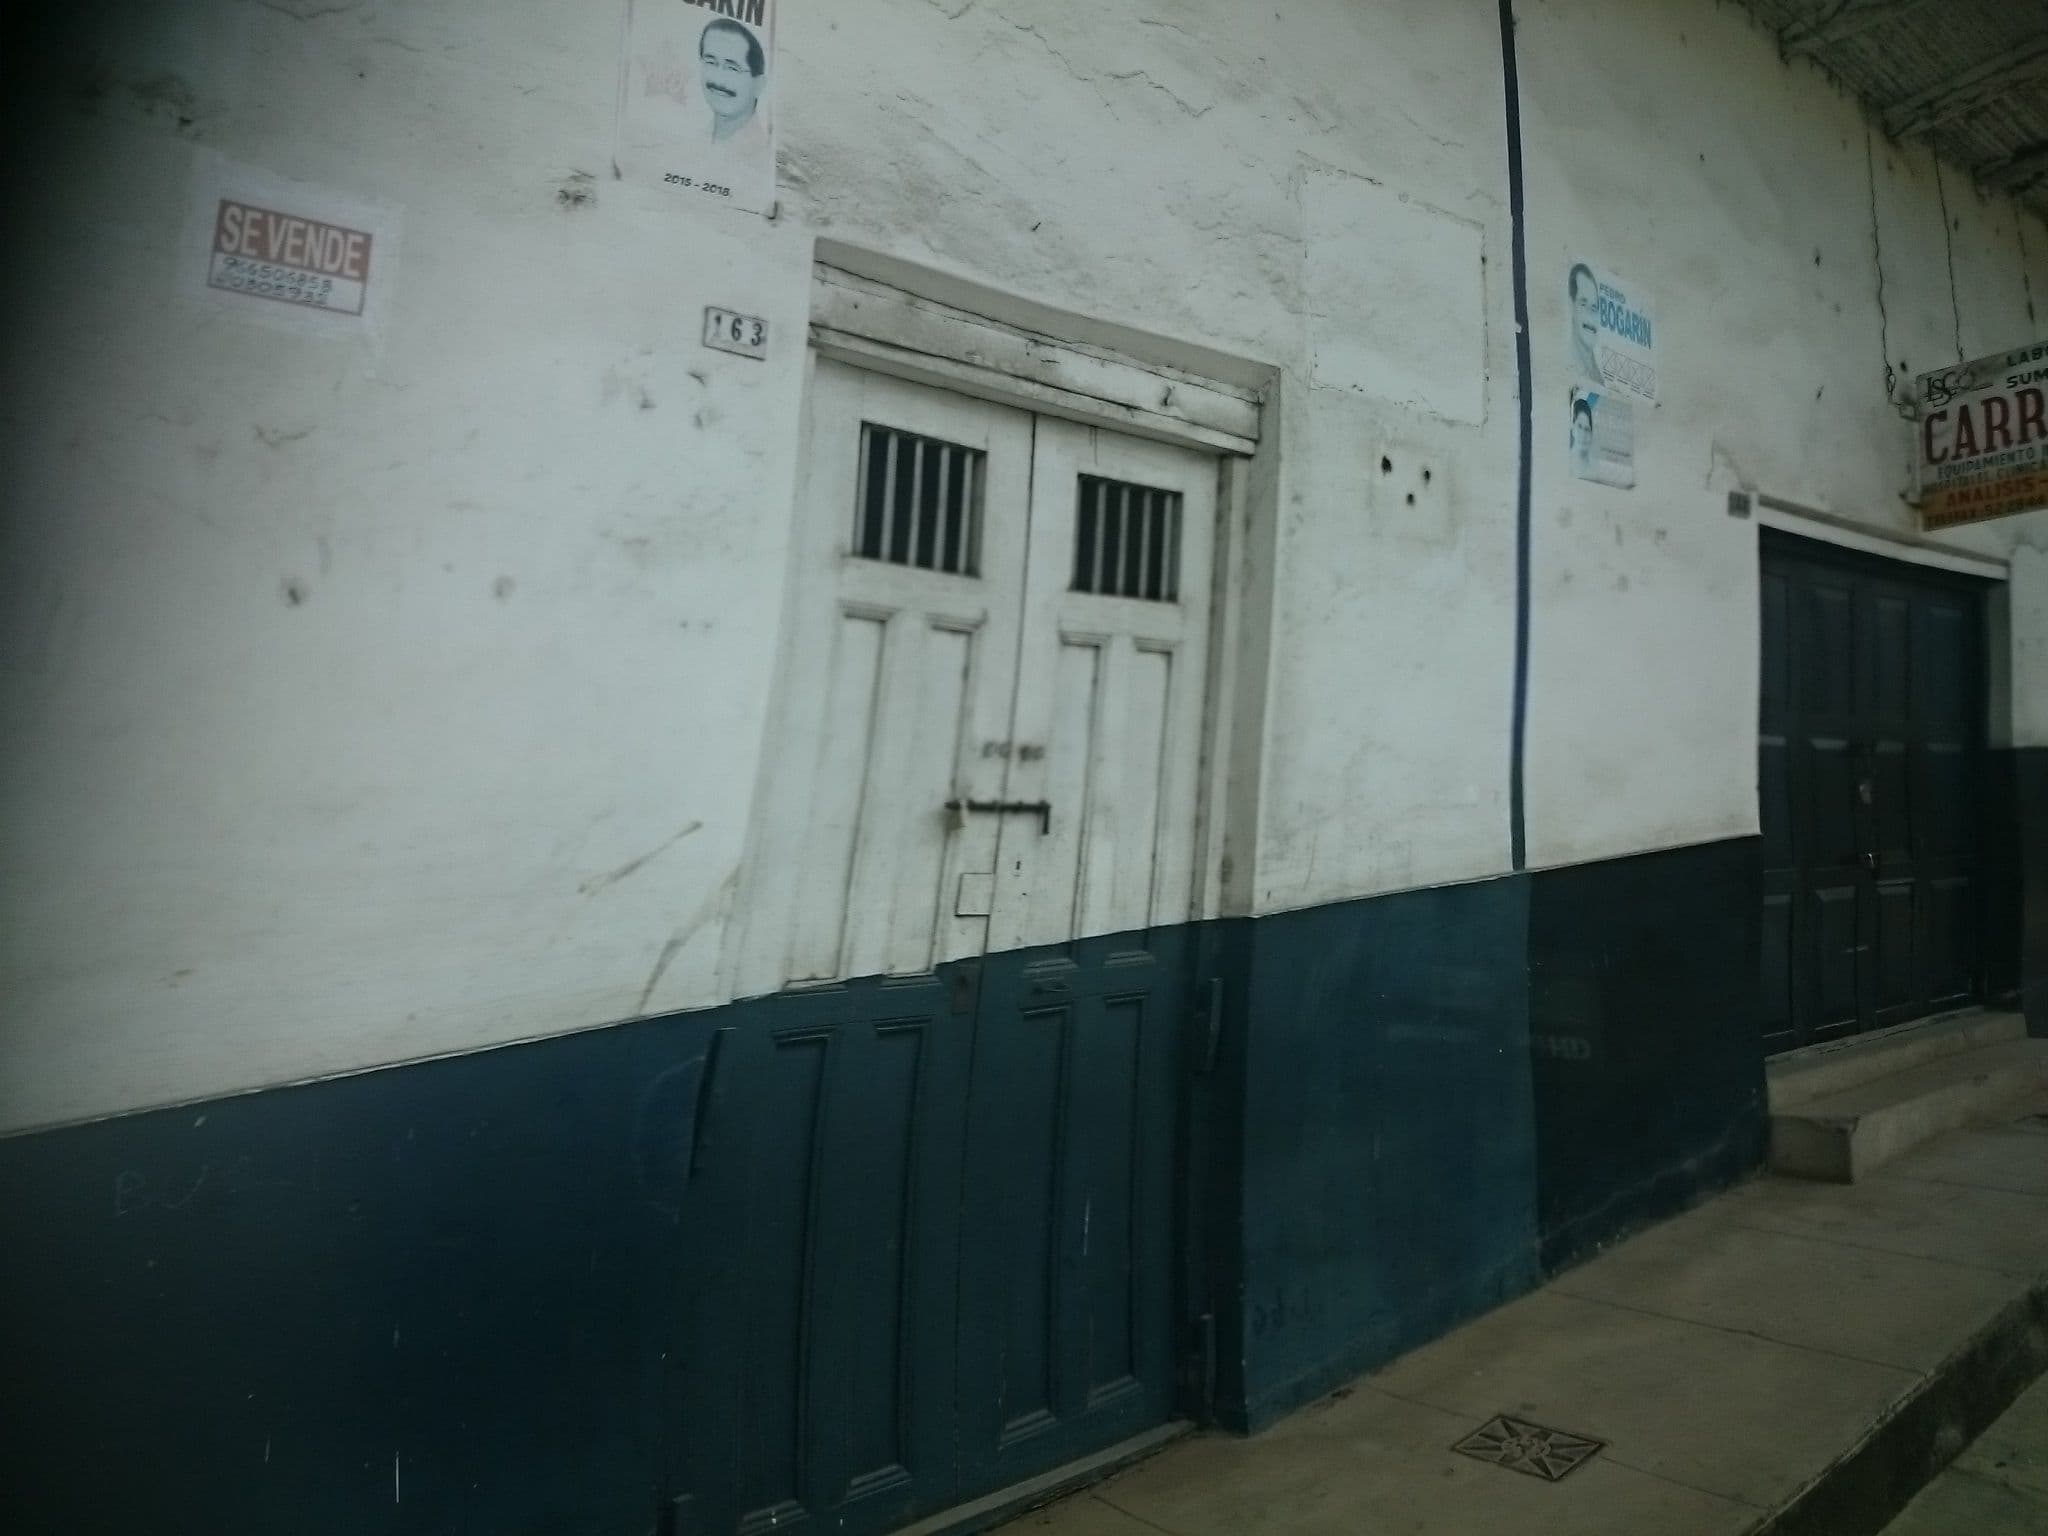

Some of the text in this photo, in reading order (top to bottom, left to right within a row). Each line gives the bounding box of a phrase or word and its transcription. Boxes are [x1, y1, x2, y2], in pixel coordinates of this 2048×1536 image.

[664, 173, 692, 187] 2015
[702, 183, 731, 197] 2018
[221, 205, 364, 277] SE VENDE
[713, 313, 762, 347] 163
[2007, 345, 2048, 368] LAB
